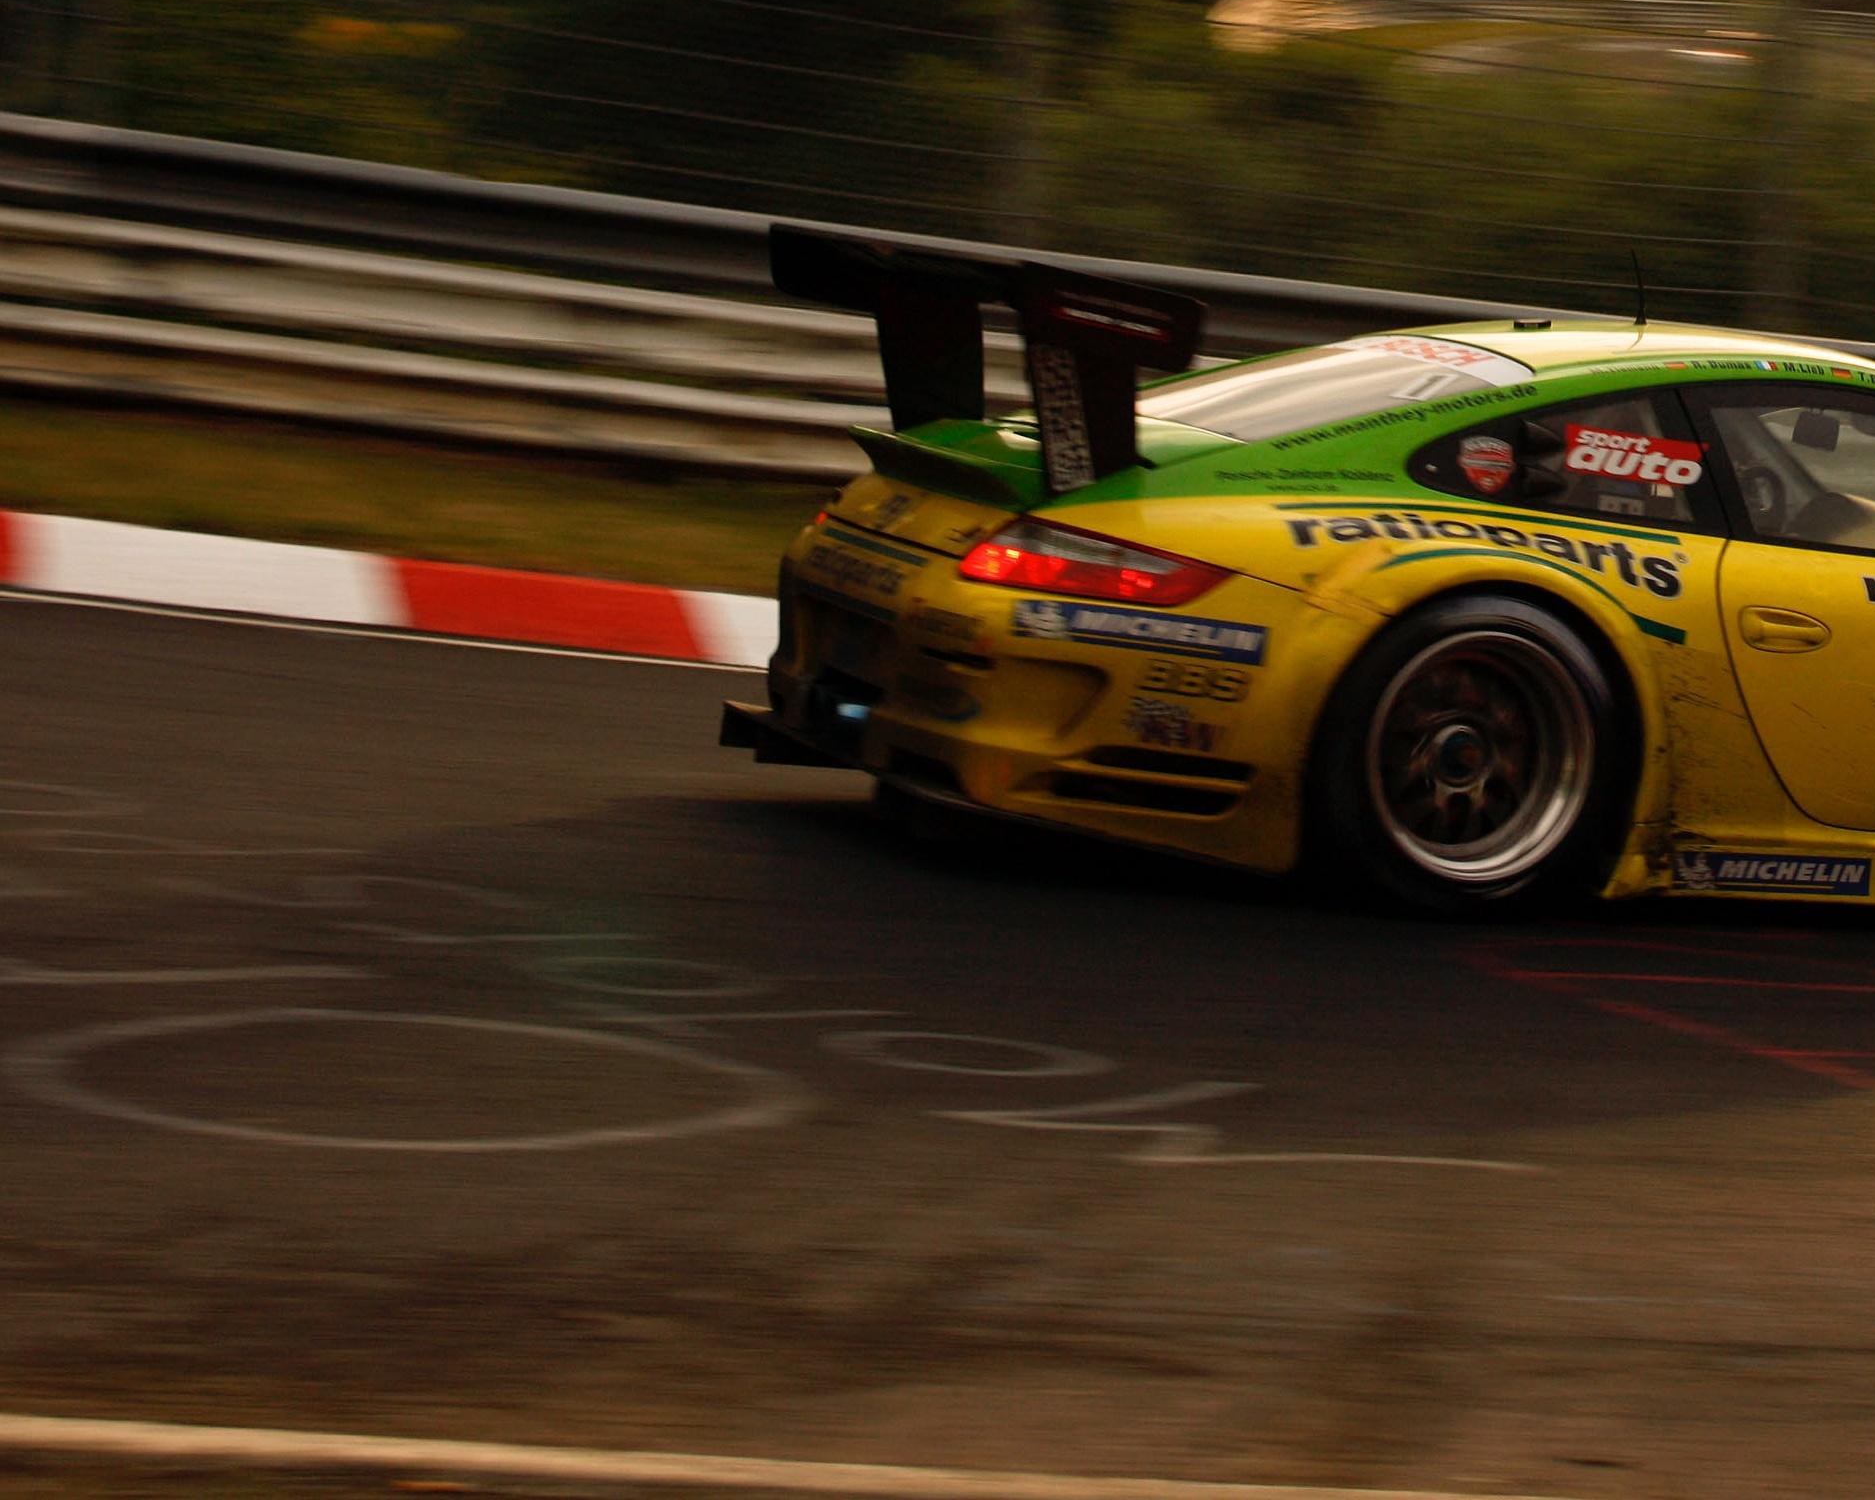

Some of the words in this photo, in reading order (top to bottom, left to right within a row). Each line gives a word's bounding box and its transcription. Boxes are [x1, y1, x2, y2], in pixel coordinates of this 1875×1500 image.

[1575, 430, 1651, 453] sport
[1567, 445, 1703, 485] auto
[1285, 512, 1684, 599] ratioparts
[1069, 609, 1264, 652] MICHELIN
[1718, 859, 1865, 884] MICHELIN
